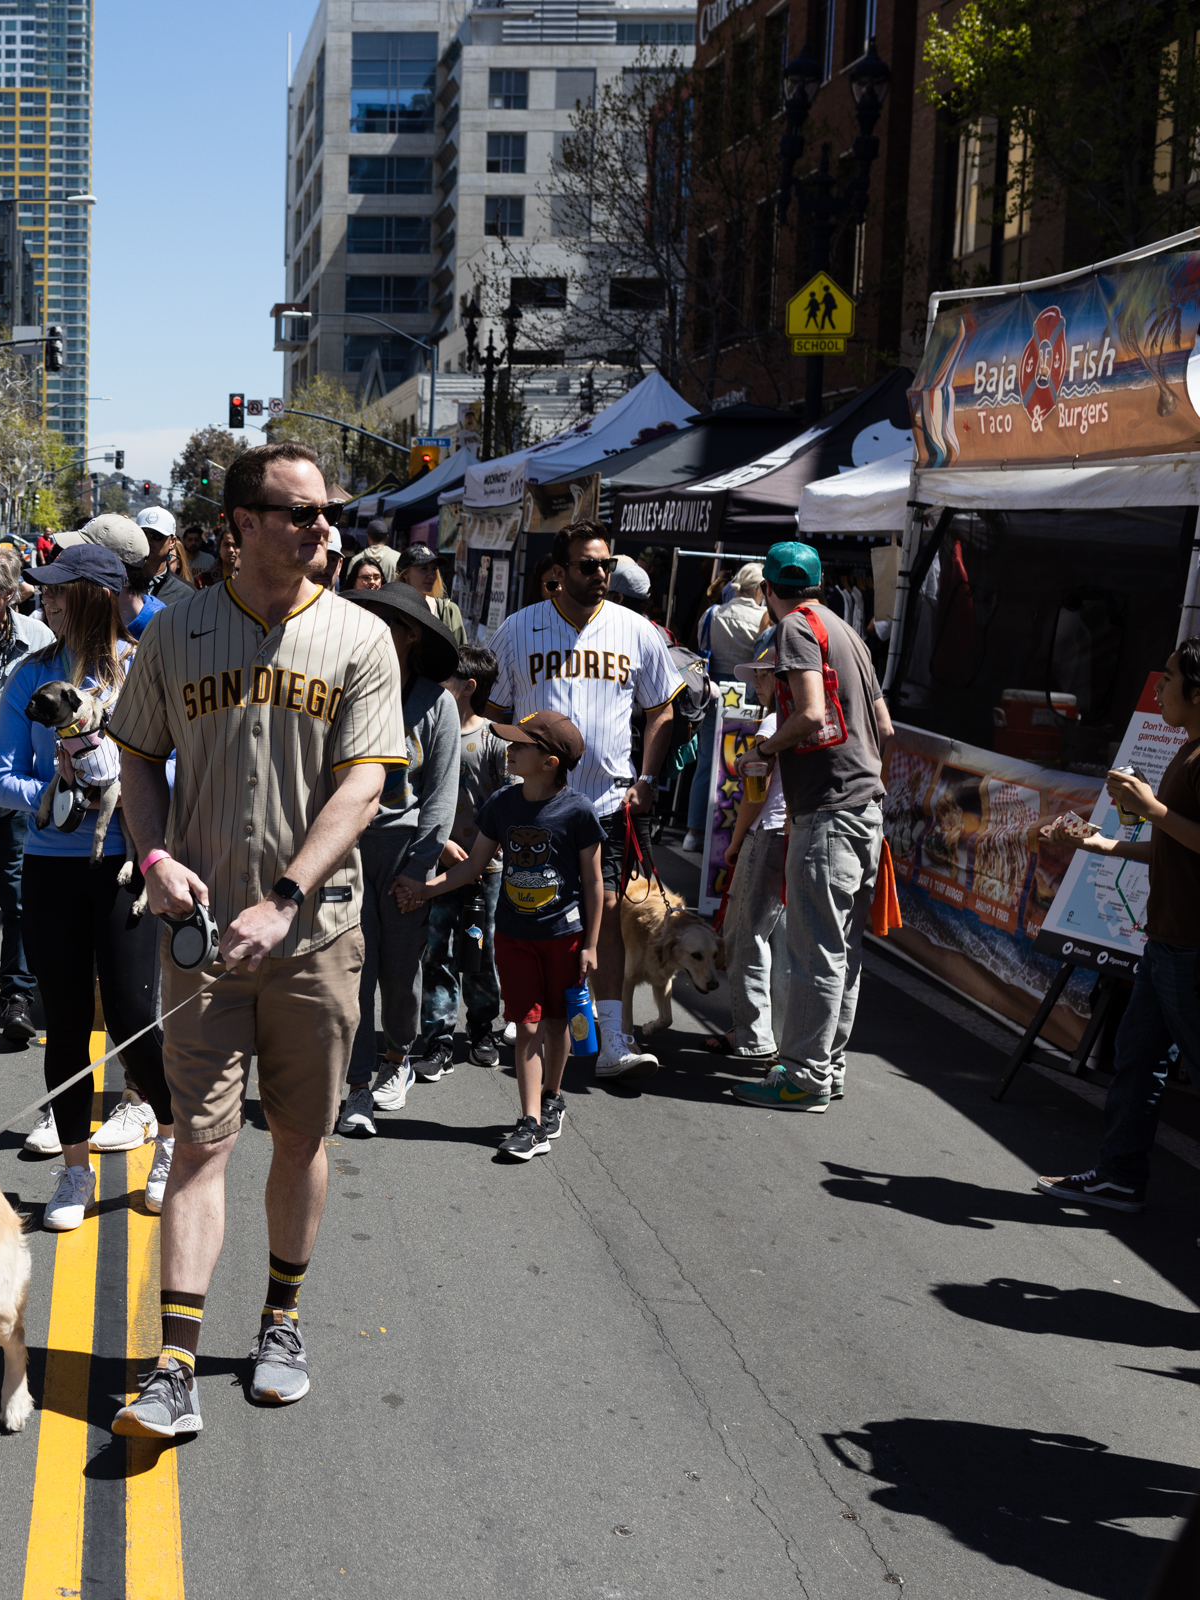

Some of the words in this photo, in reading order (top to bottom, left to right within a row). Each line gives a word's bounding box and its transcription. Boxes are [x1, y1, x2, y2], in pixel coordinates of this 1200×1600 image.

[796, 340, 841, 351] SCHOOL
[973, 354, 1017, 401] Baja
[1068, 336, 1116, 382] Fish
[977, 411, 1012, 434] Taco
[1031, 404, 1044, 433] &
[1058, 401, 1109, 435] Burgers
[528, 649, 631, 686] PADRES
[182, 667, 246, 723] SAN
[249, 665, 344, 726] DIEGO
[1137, 732, 1173, 746] gameday
[1142, 721, 1163, 732] Don't
[1163, 724, 1181, 734] miss
[945, 885, 963, 903] BURGER
